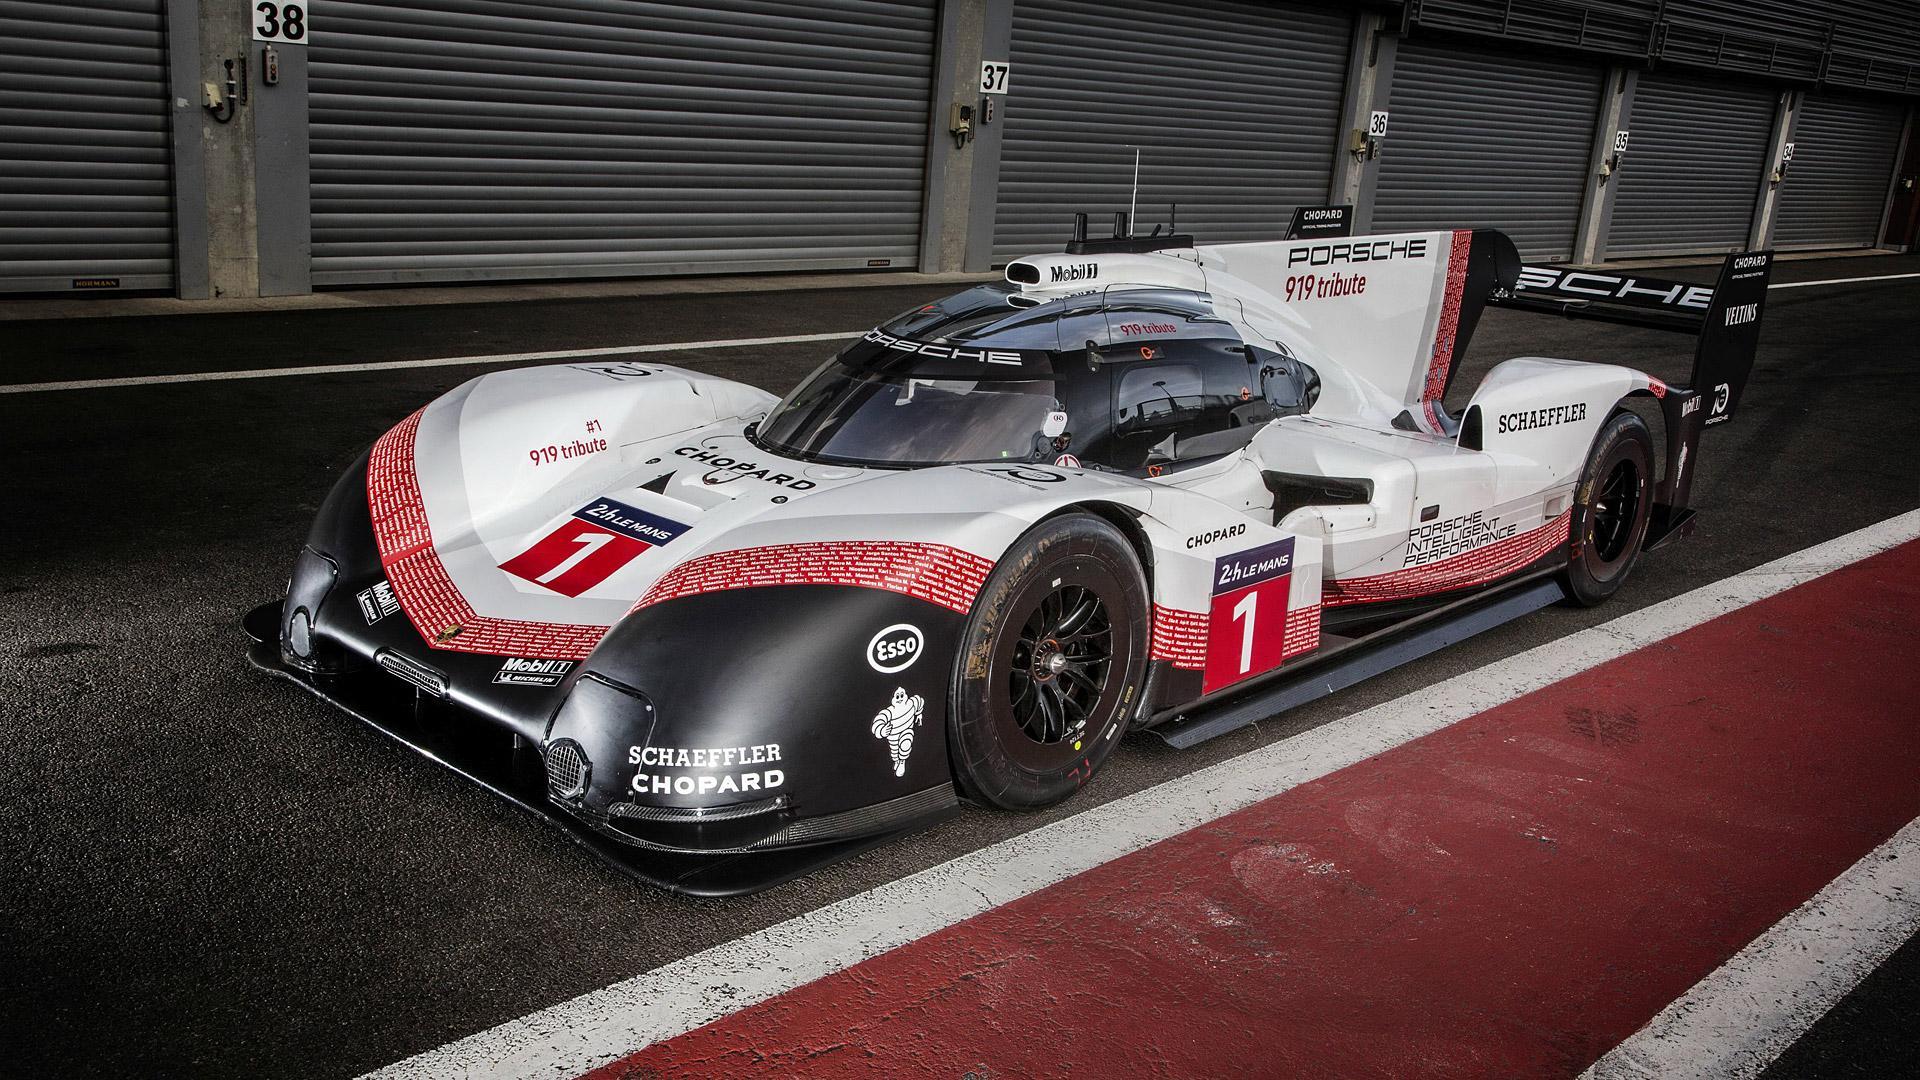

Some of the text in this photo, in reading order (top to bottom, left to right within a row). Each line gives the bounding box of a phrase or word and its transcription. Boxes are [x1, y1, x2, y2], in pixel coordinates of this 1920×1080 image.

[257, 2, 304, 40] 38
[983, 65, 1007, 90] 37
[1372, 114, 1386, 133] 36
[1616, 133, 1627, 148] 35
[1784, 146, 1792, 158] 34
[1304, 210, 1342, 220] CHOPARD
[1288, 240, 1426, 268] PORSCHE
[1735, 256, 1766, 269] CHOPARD
[1050, 264, 1097, 282] Mobil 1
[1285, 273, 1366, 302] 919 tribute
[1516, 266, 1714, 308] SCHE
[1725, 303, 1758, 326] VELTINS
[1120, 322, 1176, 336] 919 tribute
[864, 327, 1022, 366] ORSCHE
[586, 420, 601, 433] #1
[1499, 403, 1586, 433] SCHAEFFLER
[530, 438, 607, 466] 919 tribute
[675, 447, 816, 491] CHOPARD
[611, 517, 634, 526] LE
[628, 523, 672, 539] MANS
[1186, 524, 1246, 548] CHOPARD
[1406, 517, 1500, 554] INTELLIGENT
[1409, 511, 1482, 541] PORSCHE
[535, 533, 616, 583] 1
[1403, 524, 1516, 567] PERFORMANCE
[1242, 564, 1257, 577] LE
[1258, 555, 1289, 573] MANS
[372, 580, 397, 608] Mobil
[1233, 591, 1257, 674] 1
[877, 637, 916, 662] Esso
[501, 658, 555, 673] Mobil
[512, 675, 555, 683] MICHELIN
[629, 743, 781, 767] SCHAEFFLER
[631, 769, 784, 794] CHOPARD
